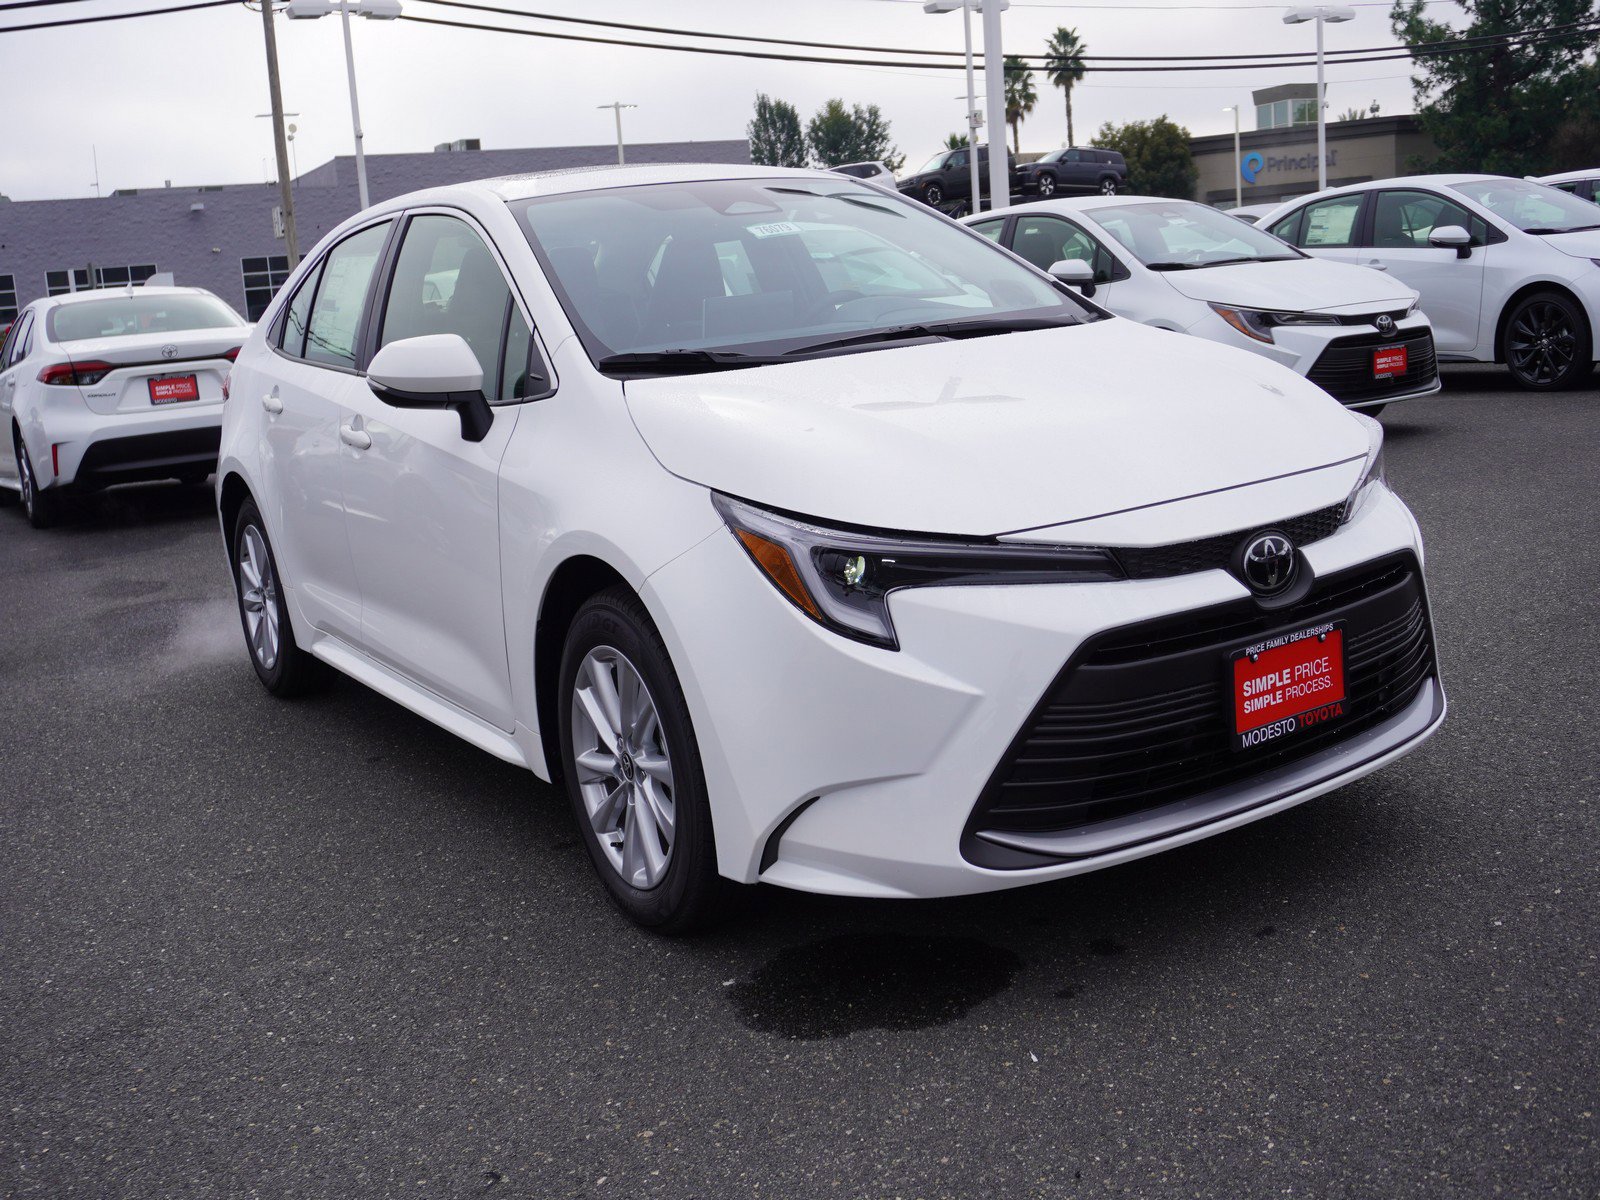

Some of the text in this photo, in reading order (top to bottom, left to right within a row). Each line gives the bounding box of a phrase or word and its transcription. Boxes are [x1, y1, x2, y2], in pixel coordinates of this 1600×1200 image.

[1267, 150, 1336, 172] Principal
[754, 223, 792, 235] 76079
[1246, 623, 1334, 656] PRICE FAMILY DEALERSHIPS
[1243, 657, 1332, 697] SIMPLE PRICE.
[1243, 675, 1334, 714] SIMPLE PROCESS.
[1242, 703, 1343, 748] MODESTO TOYOTA
